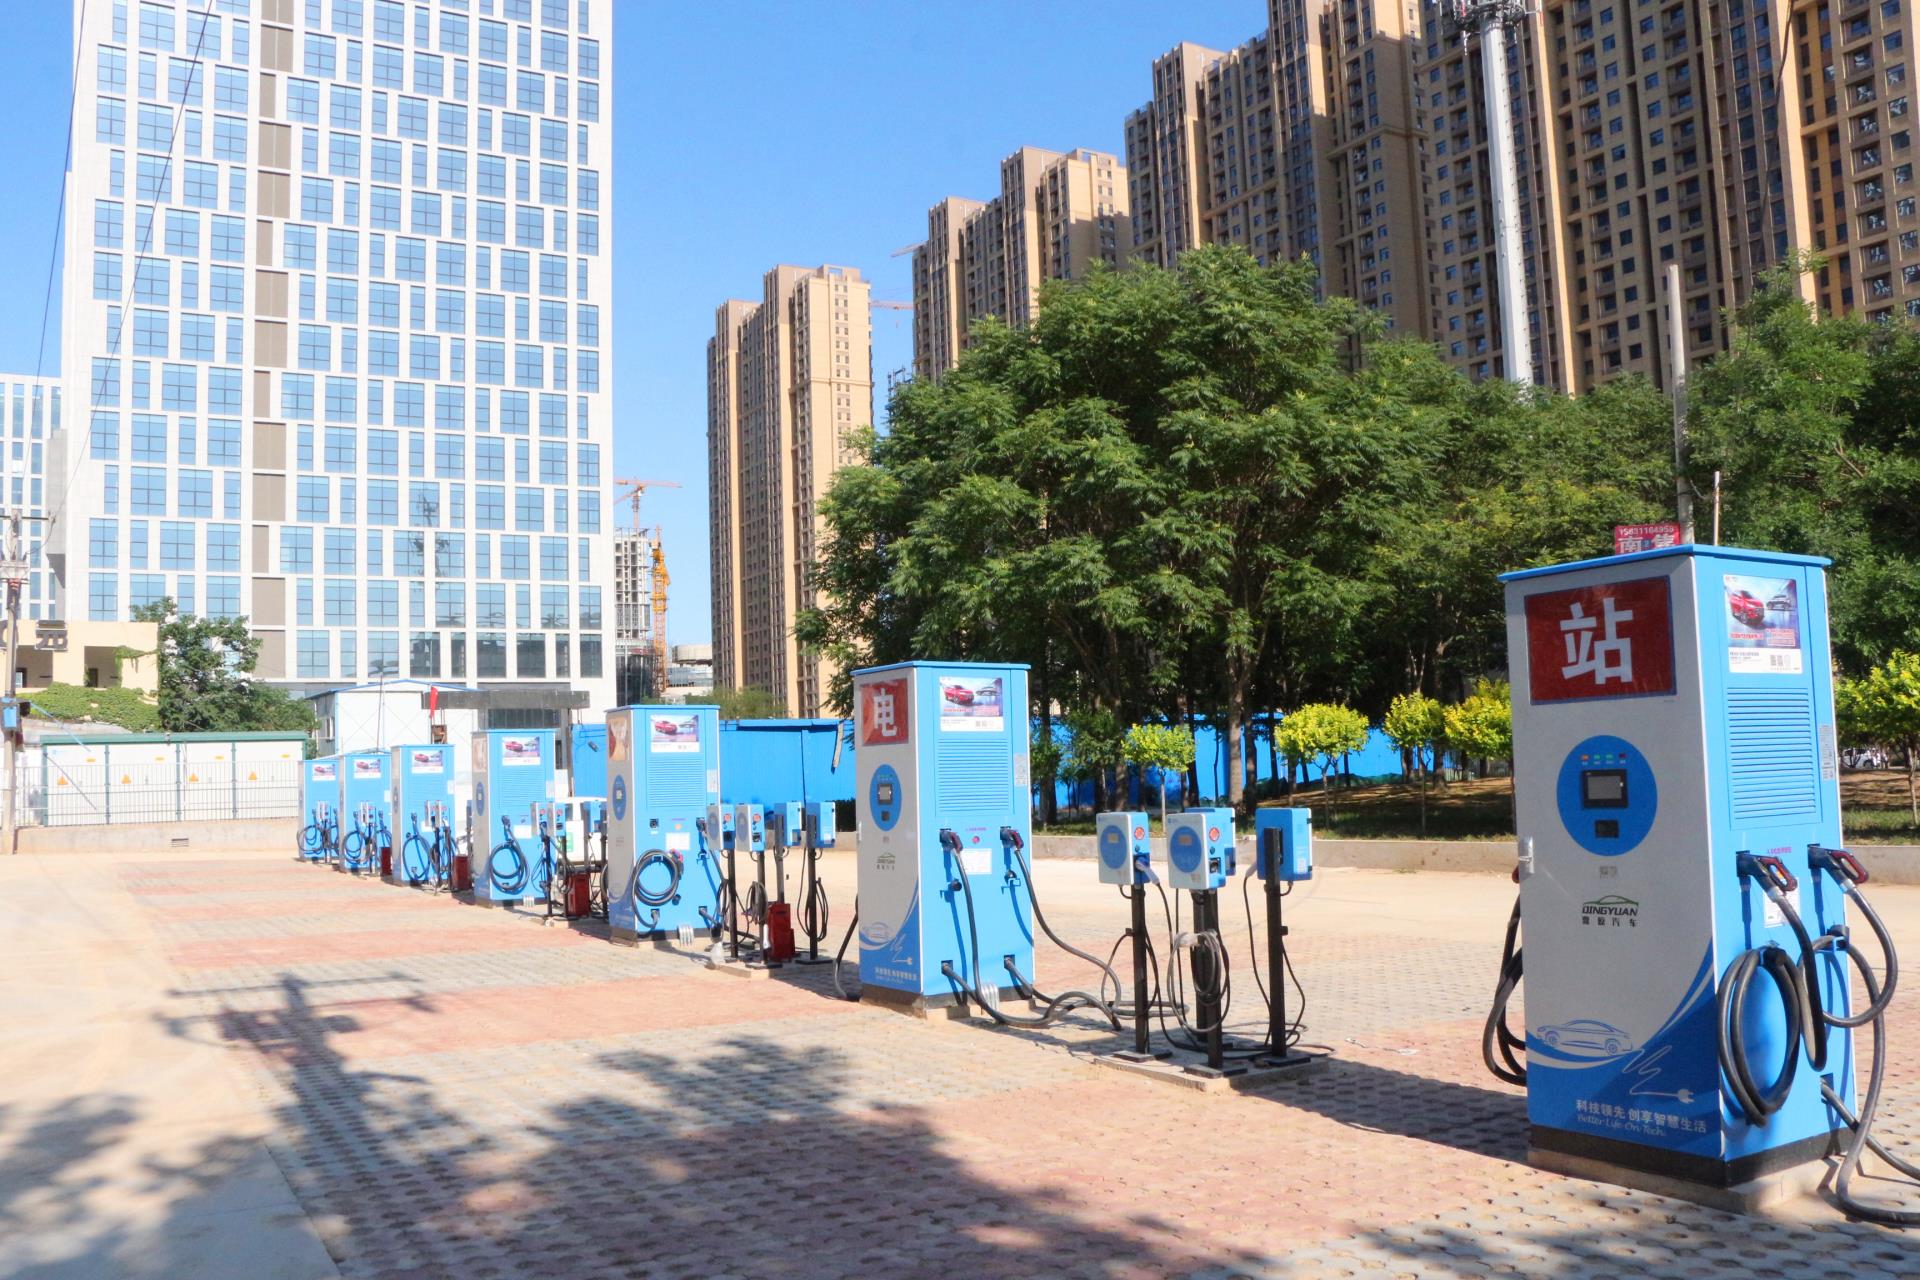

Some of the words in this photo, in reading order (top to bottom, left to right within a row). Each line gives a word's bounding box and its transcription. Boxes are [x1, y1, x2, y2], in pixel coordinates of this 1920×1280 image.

[1560, 597, 1633, 685] 站
[873, 687, 898, 737] 电
[1576, 1099, 1626, 1119] 科技领先
